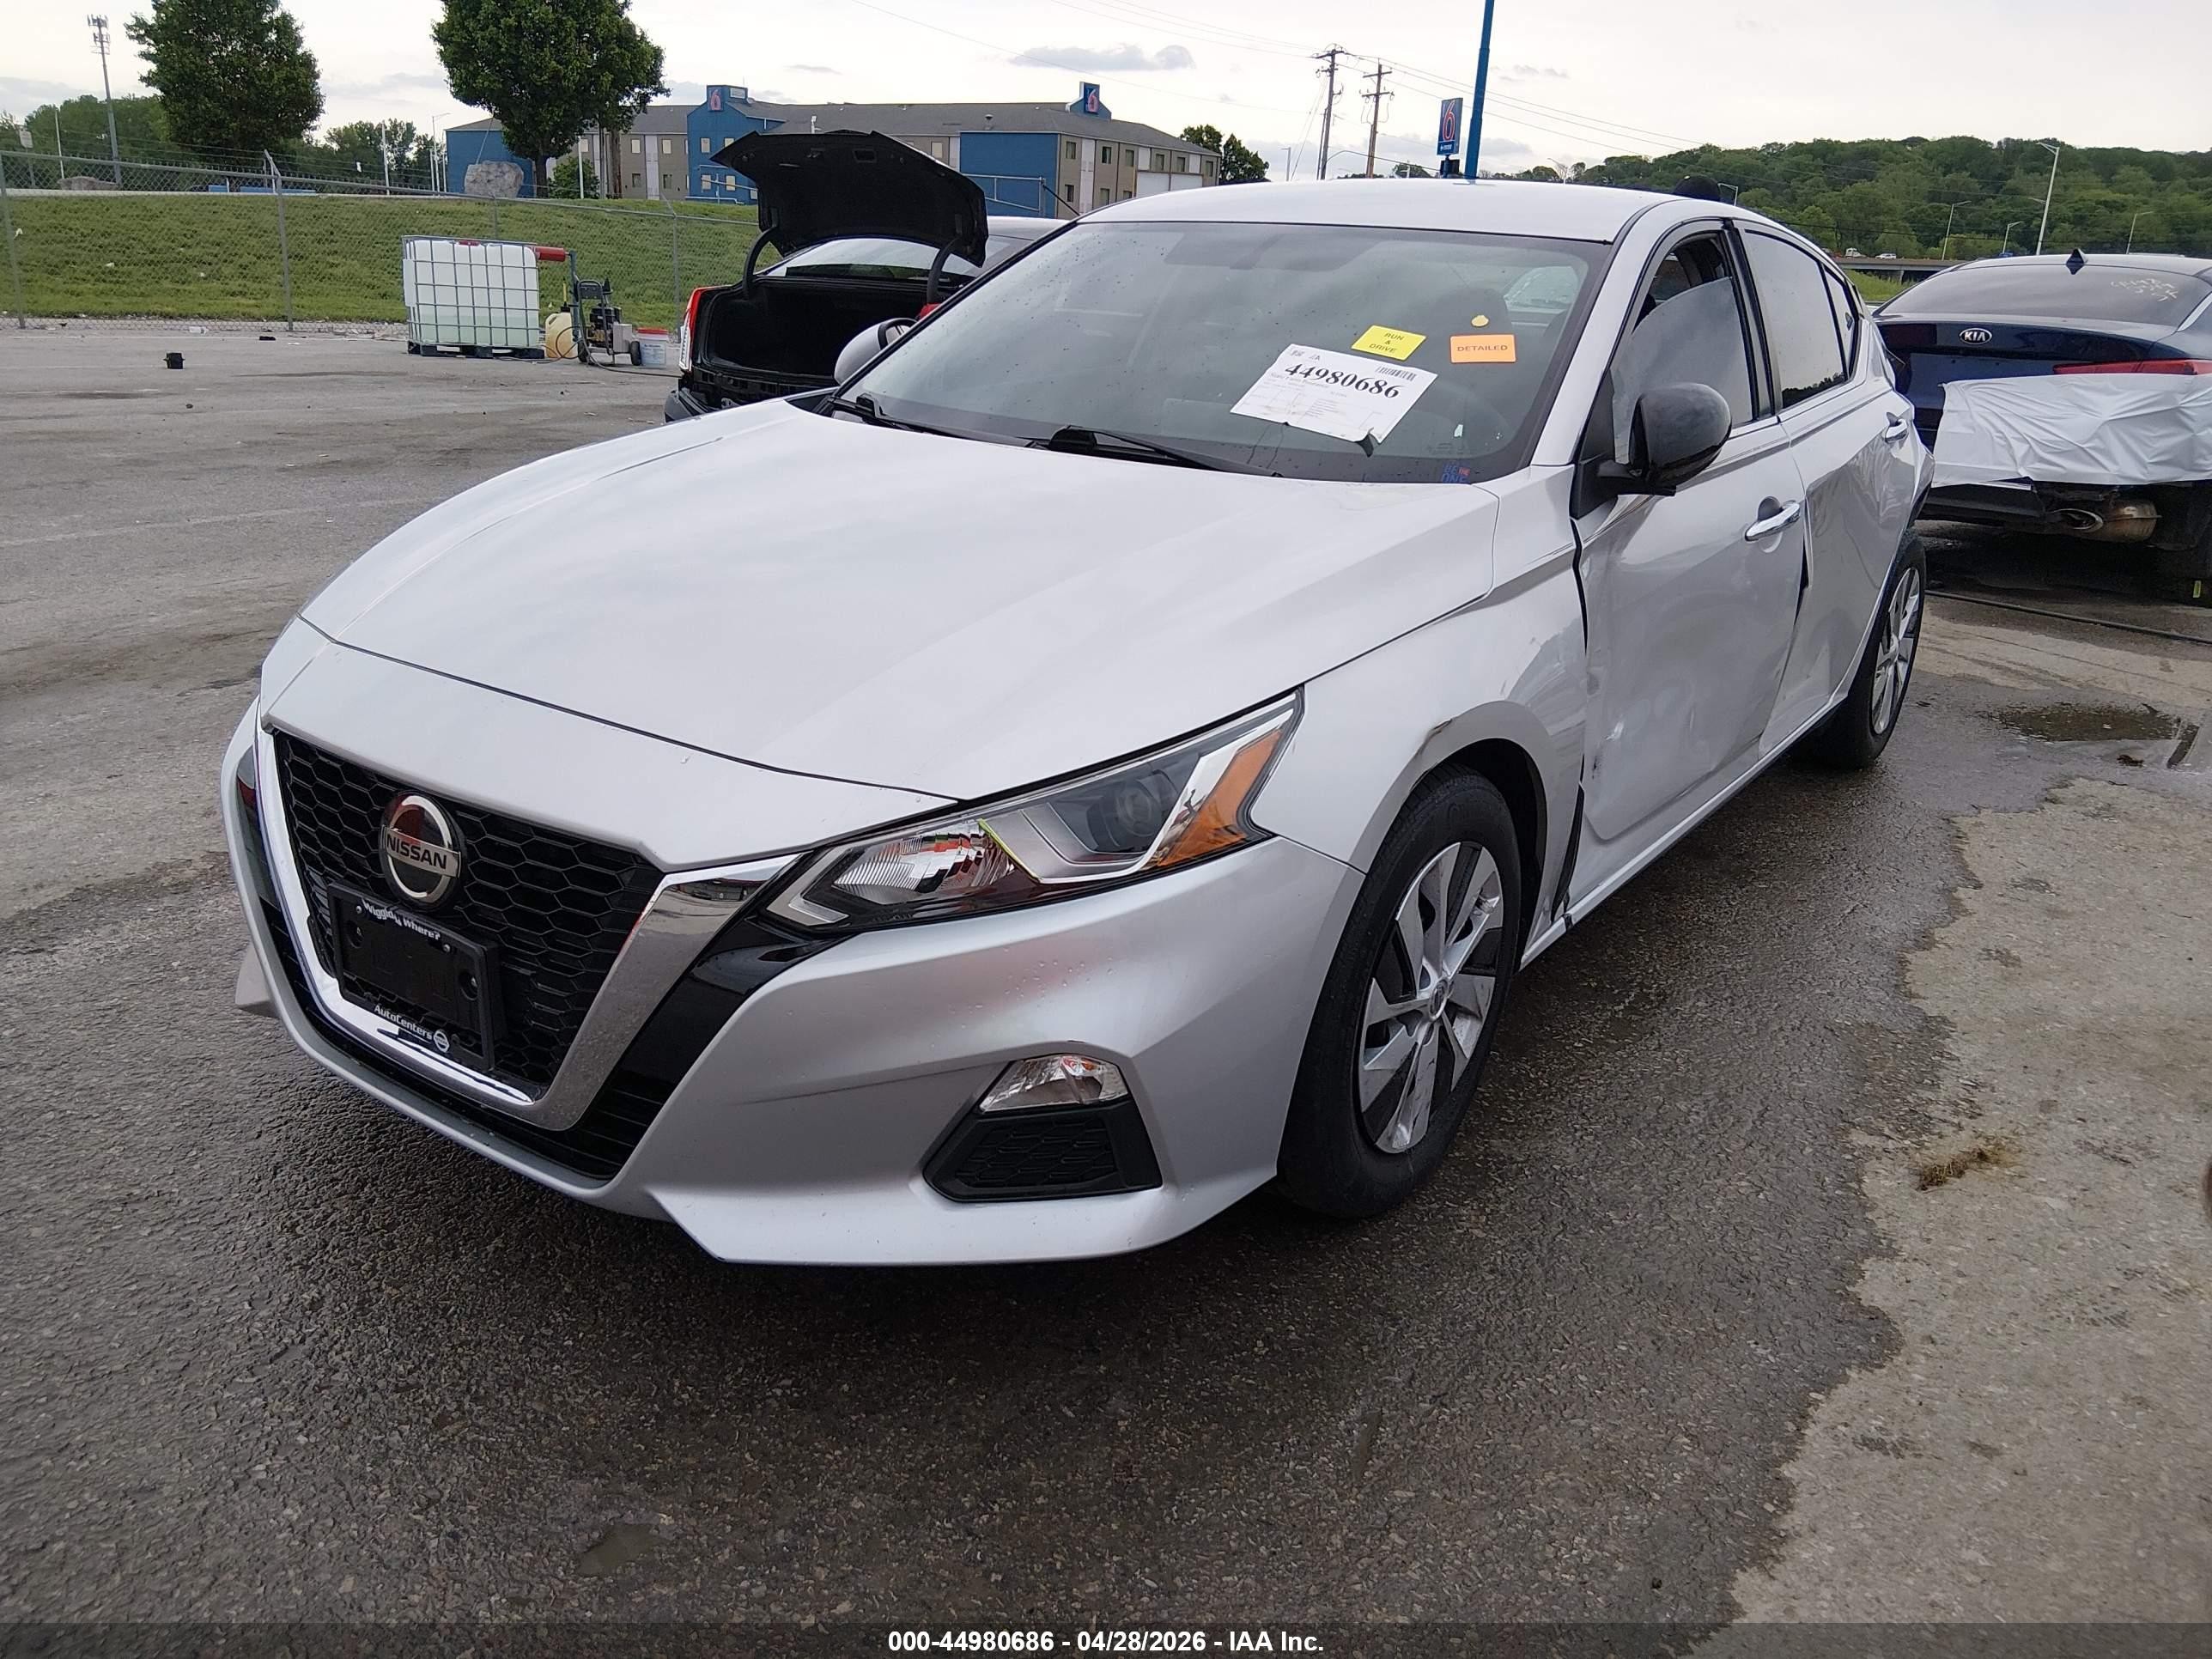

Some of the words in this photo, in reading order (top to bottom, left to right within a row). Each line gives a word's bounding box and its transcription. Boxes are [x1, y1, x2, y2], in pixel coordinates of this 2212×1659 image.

[1088, 88, 1097, 112] 6
[1443, 100, 1455, 142] 6
[1369, 343, 1398, 354] DRIVE
[1383, 331, 1405, 342] RUN
[1964, 331, 1986, 342] KIA
[1285, 362, 1406, 398] 44980686
[386, 833, 447, 870] NISSAN
[402, 916, 441, 940] Where?
[374, 1004, 433, 1041] AutoCenters
